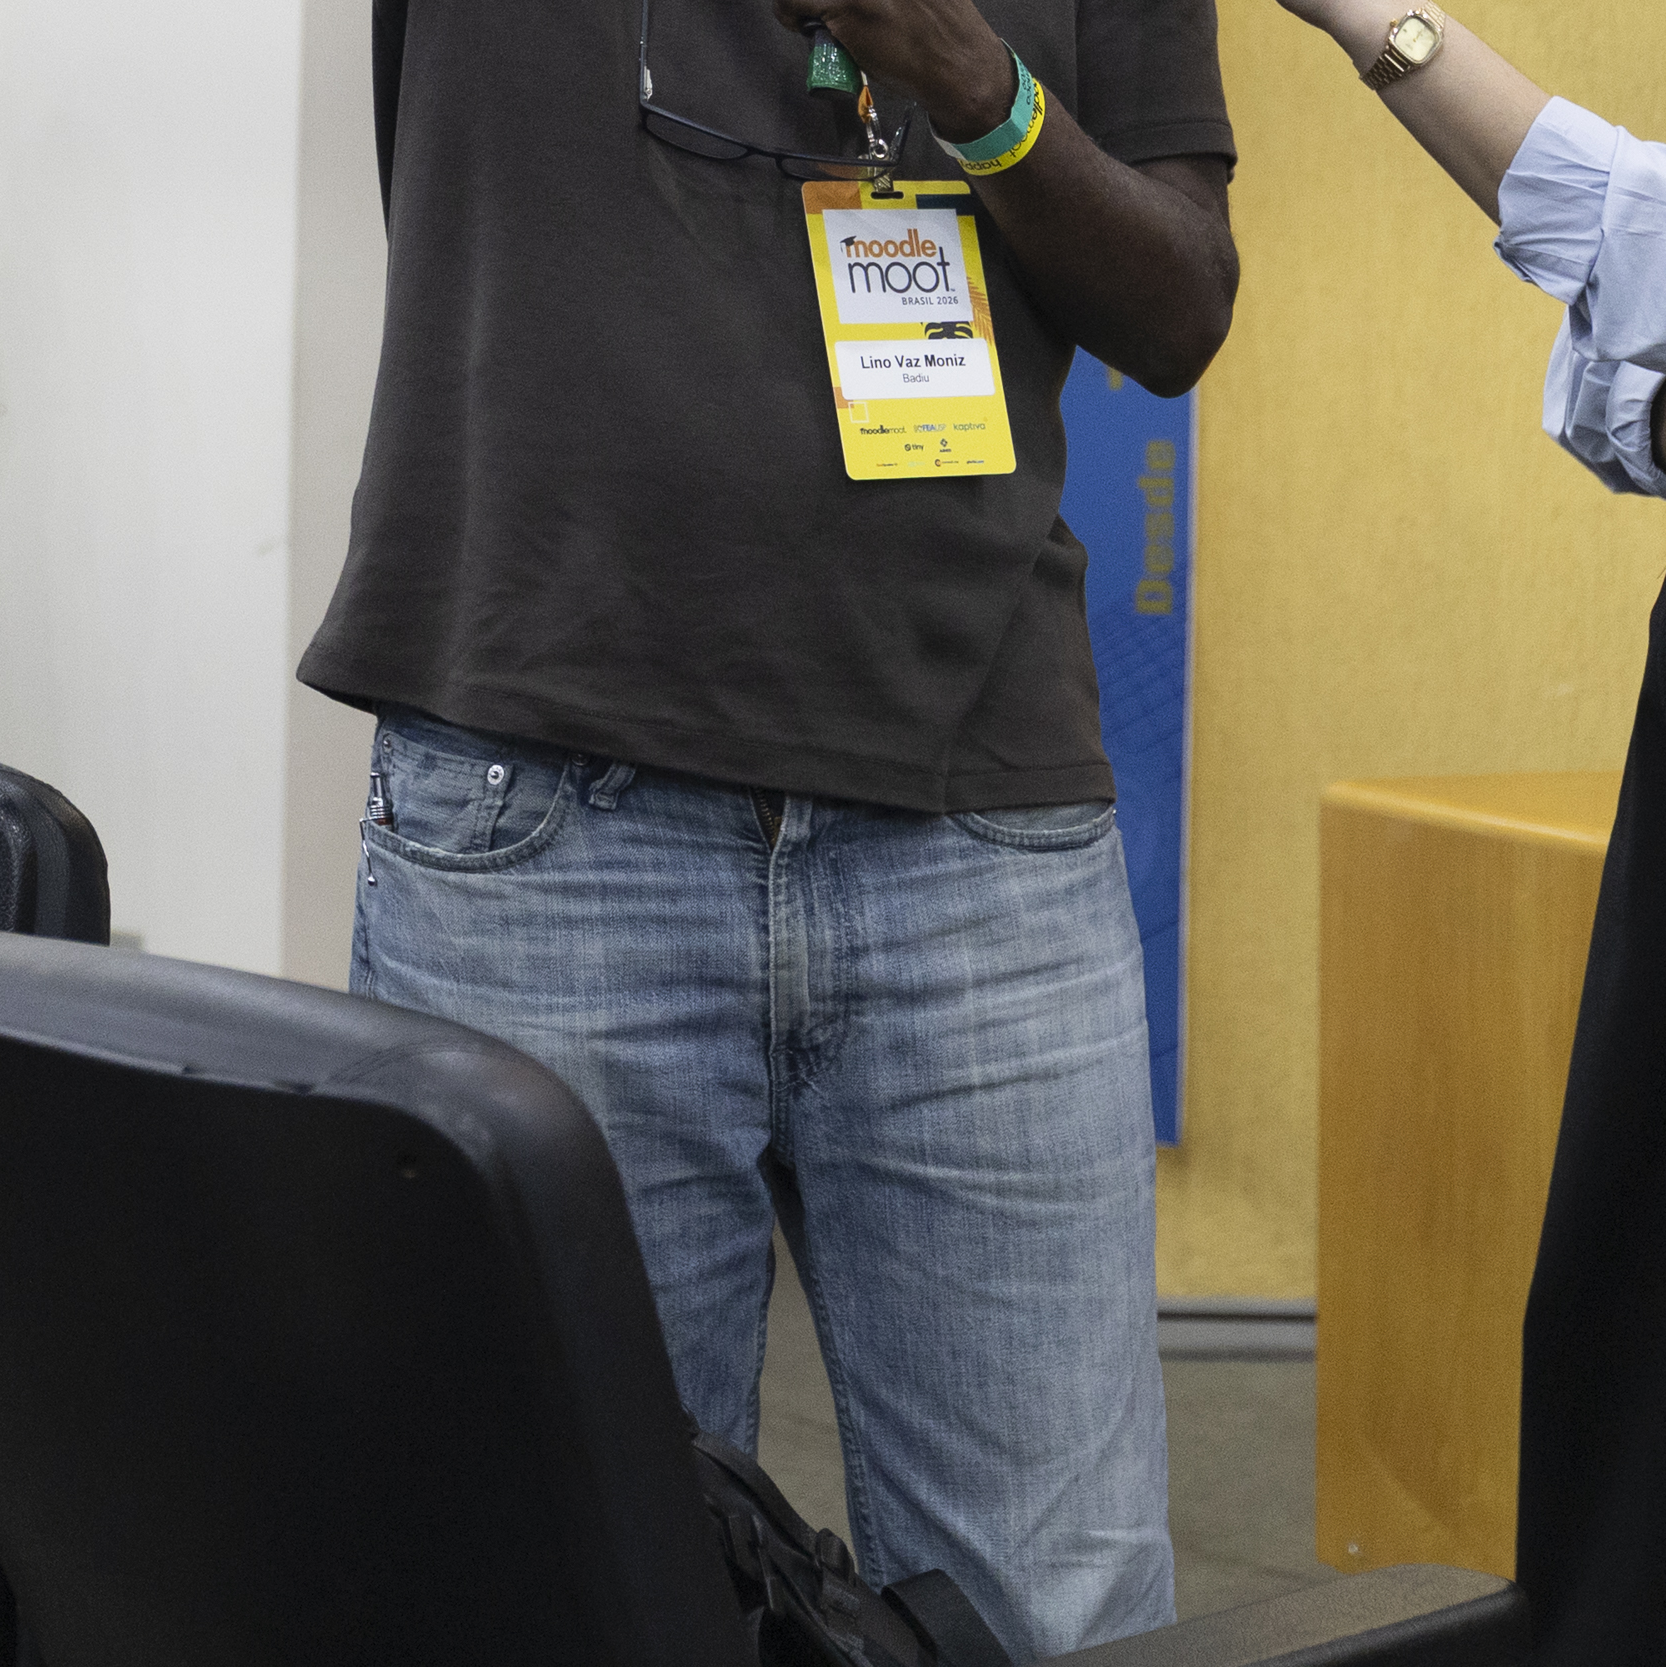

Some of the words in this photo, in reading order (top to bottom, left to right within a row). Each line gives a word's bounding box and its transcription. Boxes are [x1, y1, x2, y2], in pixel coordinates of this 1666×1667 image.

[845, 228, 937, 258] moodle
[848, 246, 950, 293] moot
[902, 297, 934, 305] BRASIL
[937, 296, 958, 305] 2026
[860, 356, 891, 368] Lino
[894, 355, 921, 368] Vaz
[924, 354, 966, 367] Moniz
[953, 423, 986, 431] kaptiva
